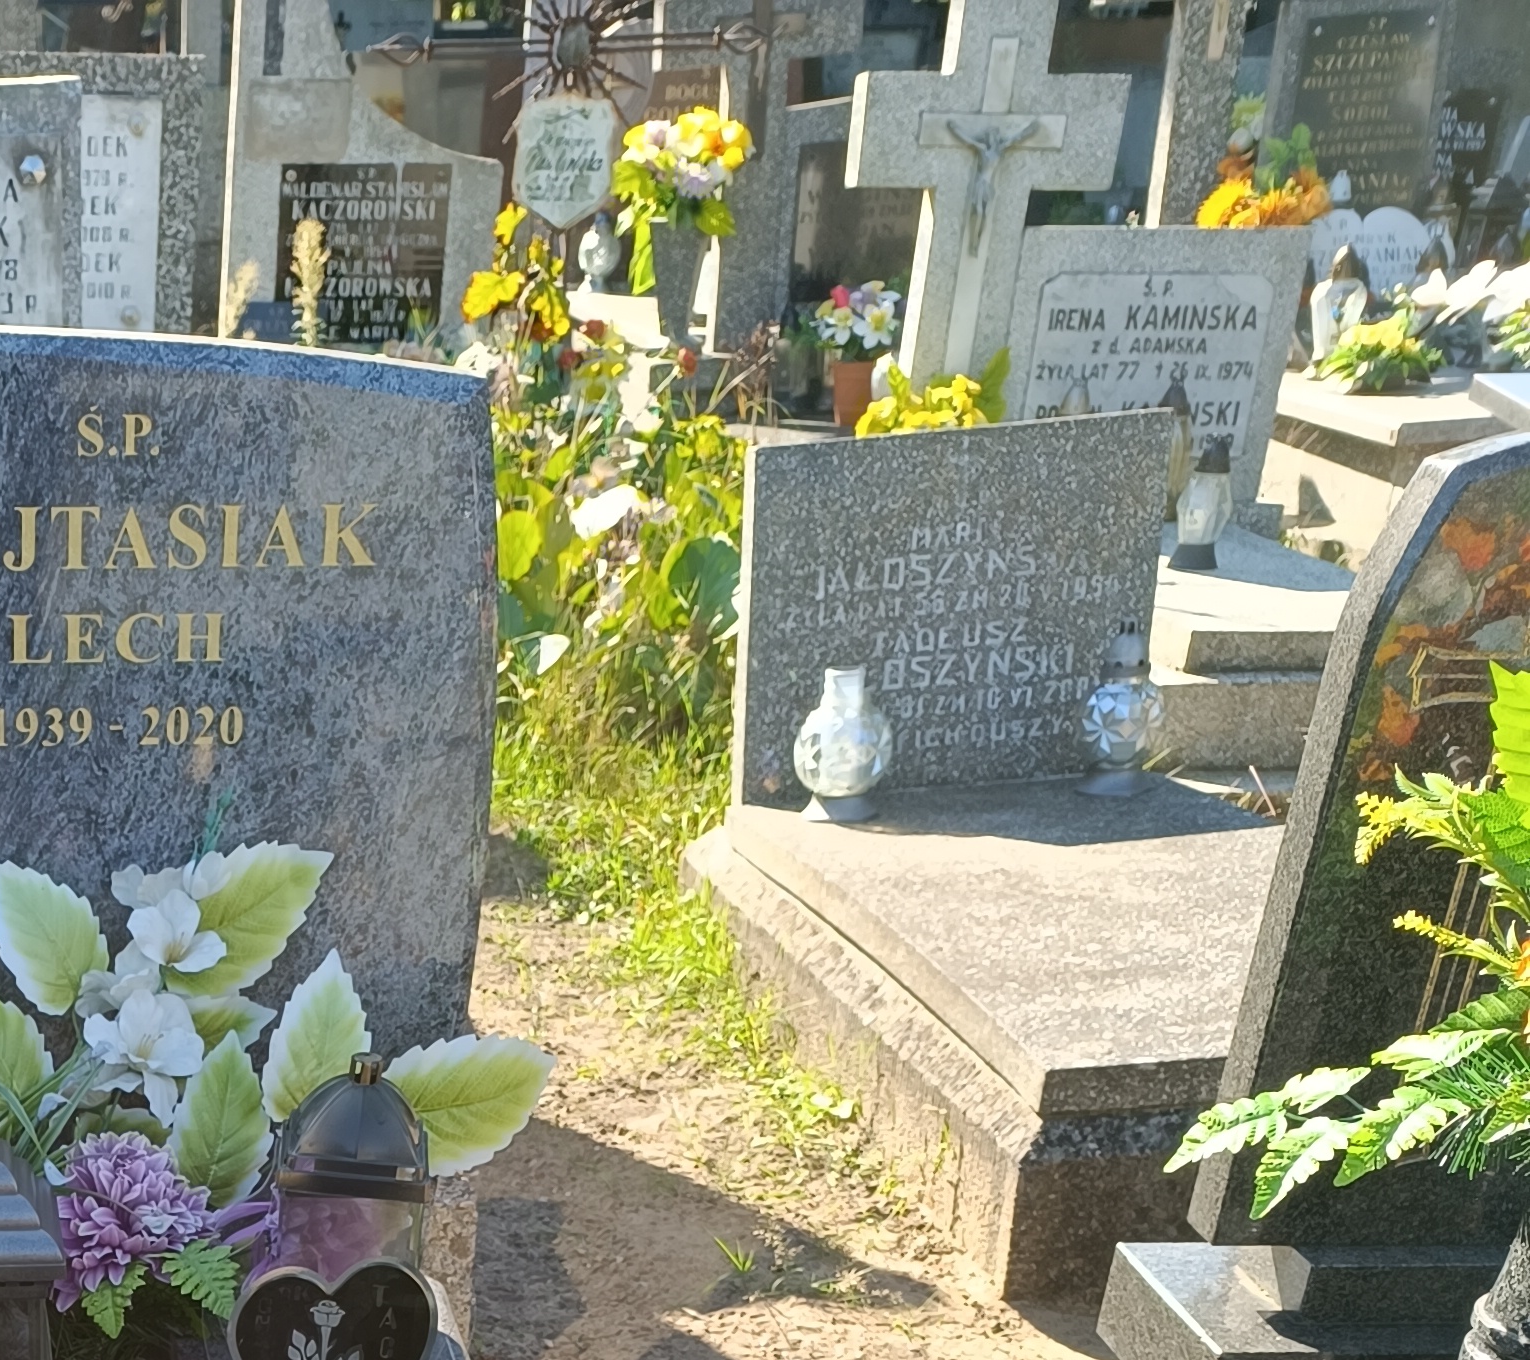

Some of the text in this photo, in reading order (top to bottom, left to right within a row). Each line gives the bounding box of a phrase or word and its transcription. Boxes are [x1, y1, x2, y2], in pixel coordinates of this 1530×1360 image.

[1047, 307, 1106, 332] IRENA
[1117, 361, 1141, 381] 77
[76, 405, 161, 458] Ś.P.
[7, 611, 224, 666] LECH
[138, 705, 245, 747] 2020
